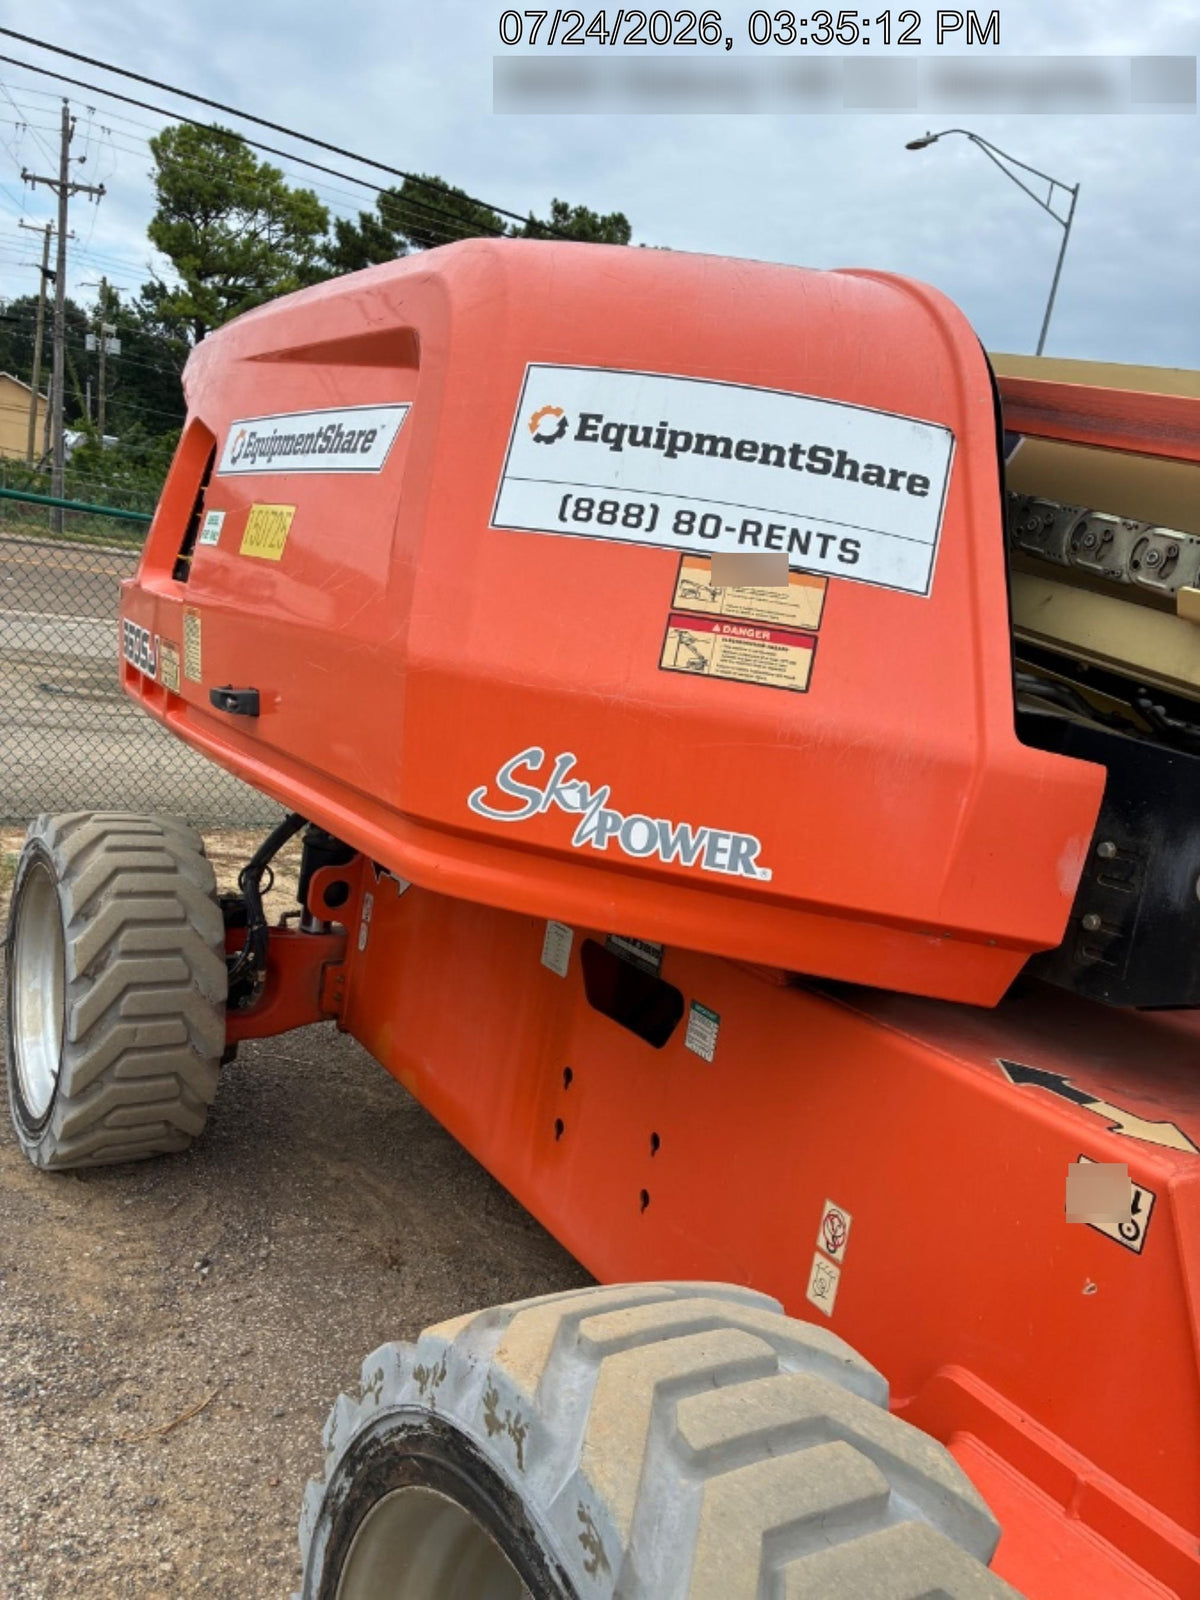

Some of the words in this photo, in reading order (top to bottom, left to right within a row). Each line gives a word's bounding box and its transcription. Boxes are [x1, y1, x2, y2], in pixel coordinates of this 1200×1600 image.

[242, 422, 378, 465] EquipmentShare
[573, 413, 932, 498] EquipmentShare
[557, 493, 660, 533] (888)
[672, 508, 863, 566] 80-RENTS
[722, 624, 771, 641] DANGER
